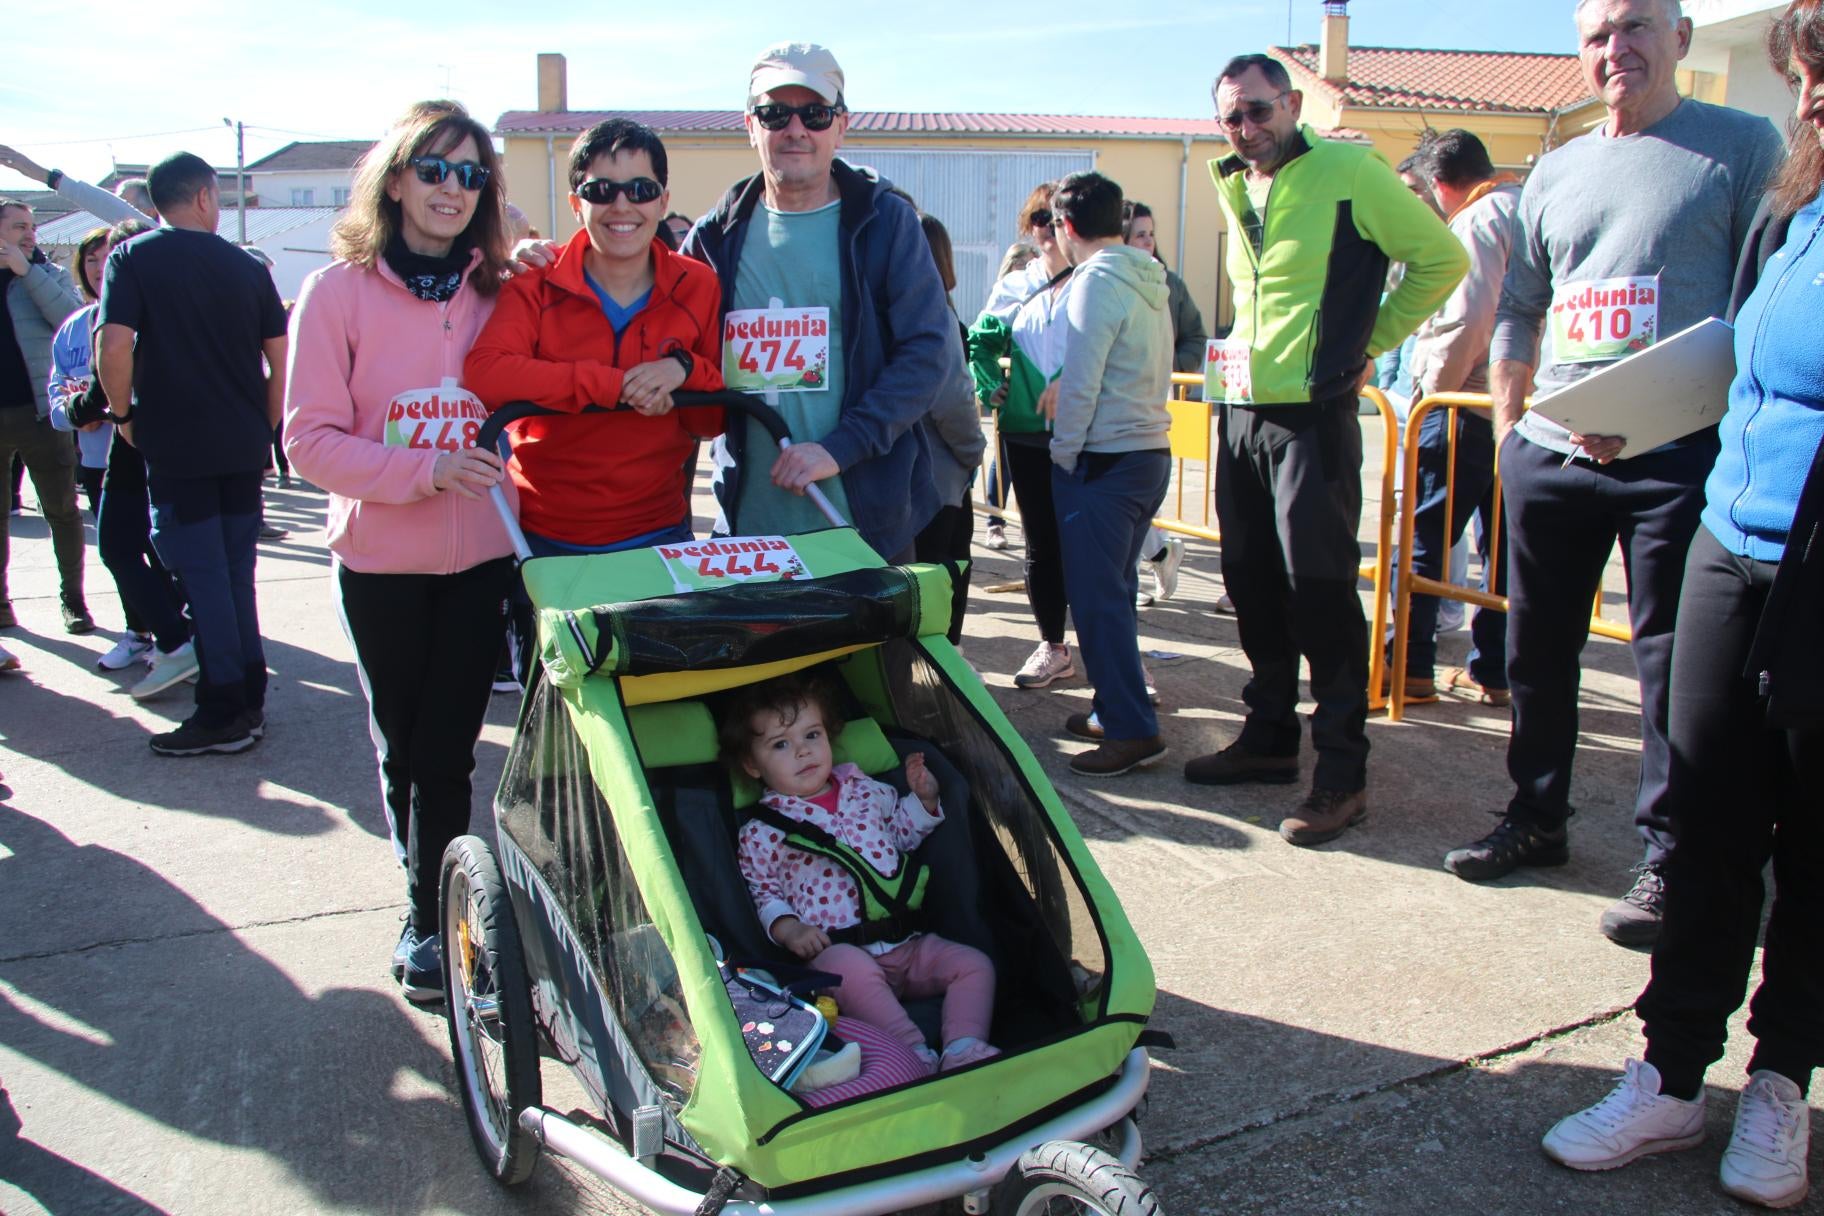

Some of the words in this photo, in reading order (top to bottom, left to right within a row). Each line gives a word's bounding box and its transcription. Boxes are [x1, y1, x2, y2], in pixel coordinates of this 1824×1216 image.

[725, 314, 826, 341] bedunia
[1567, 308, 1631, 343] 410
[738, 339, 806, 373] 474
[409, 421, 481, 453] 448
[659, 538, 790, 560] bedunia
[698, 553, 781, 577] 444
